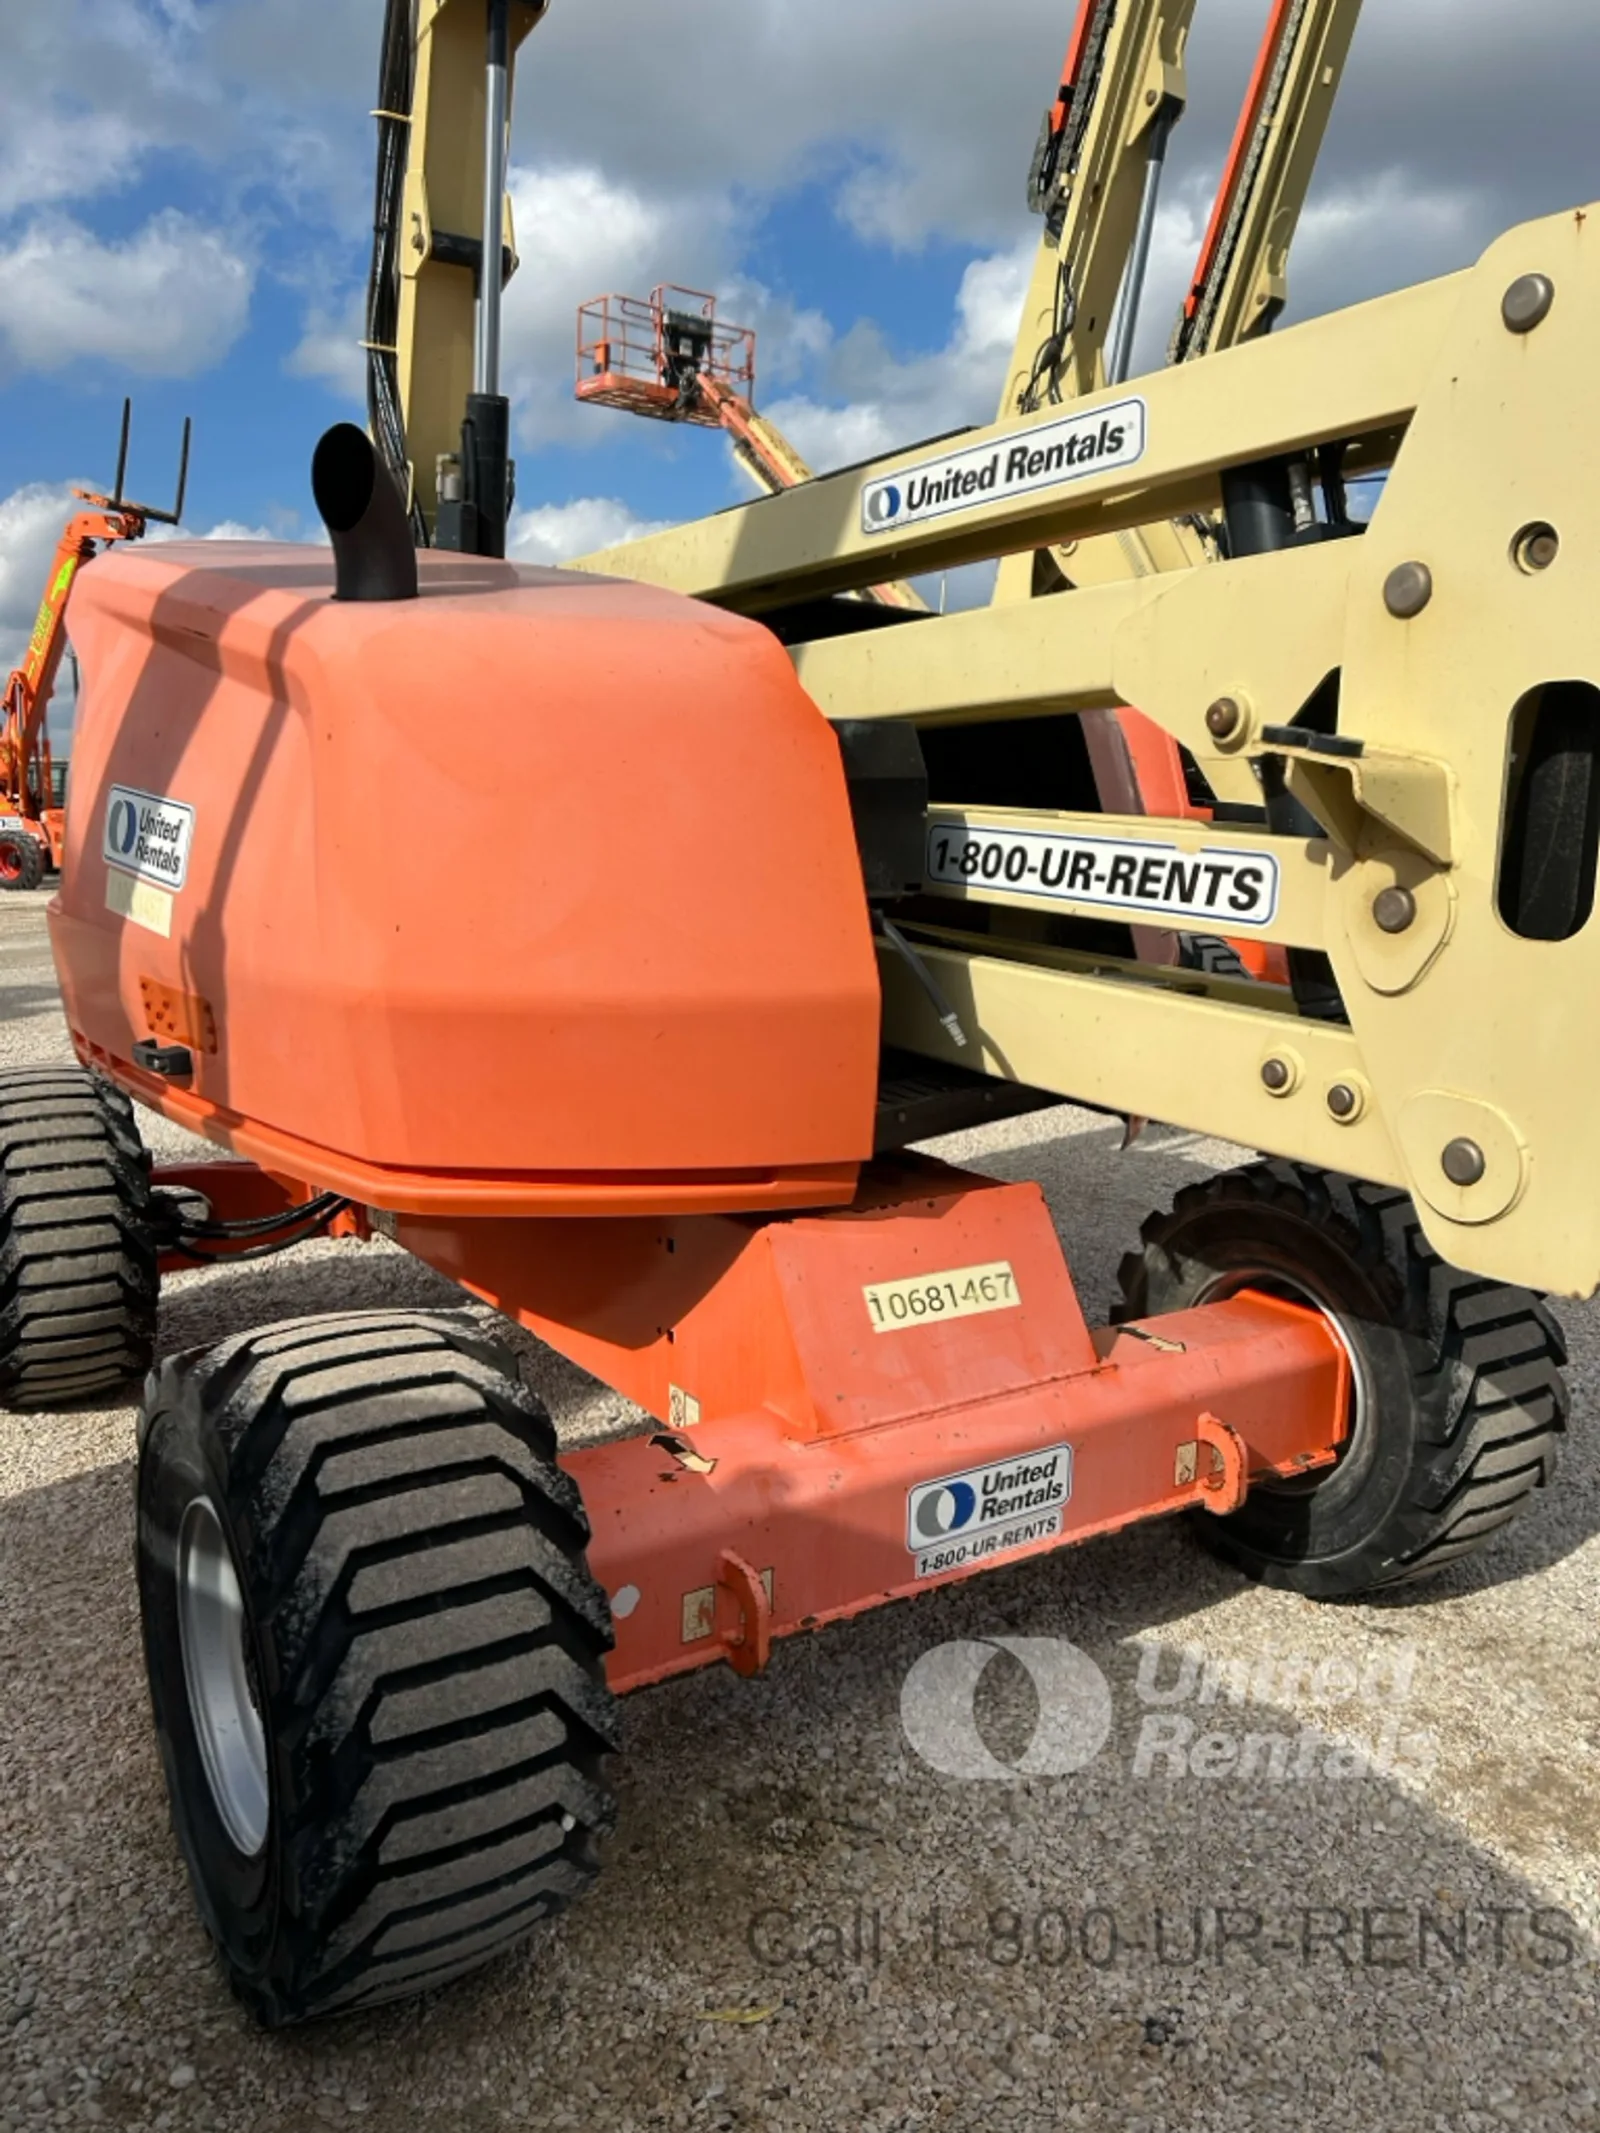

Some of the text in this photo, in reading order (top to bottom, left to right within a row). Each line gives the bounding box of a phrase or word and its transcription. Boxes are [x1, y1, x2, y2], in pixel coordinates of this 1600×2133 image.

[906, 421, 1125, 510] United Rentals
[140, 808, 181, 843] United
[135, 836, 181, 874] Rentals
[934, 838, 1265, 911] 1-800-UR-RENTS
[868, 1272, 1012, 1322] 10681467
[981, 1455, 1059, 1496] United
[979, 1480, 1063, 1522] Rentals
[920, 1516, 1058, 1574] 1-800-UR-RENTS
